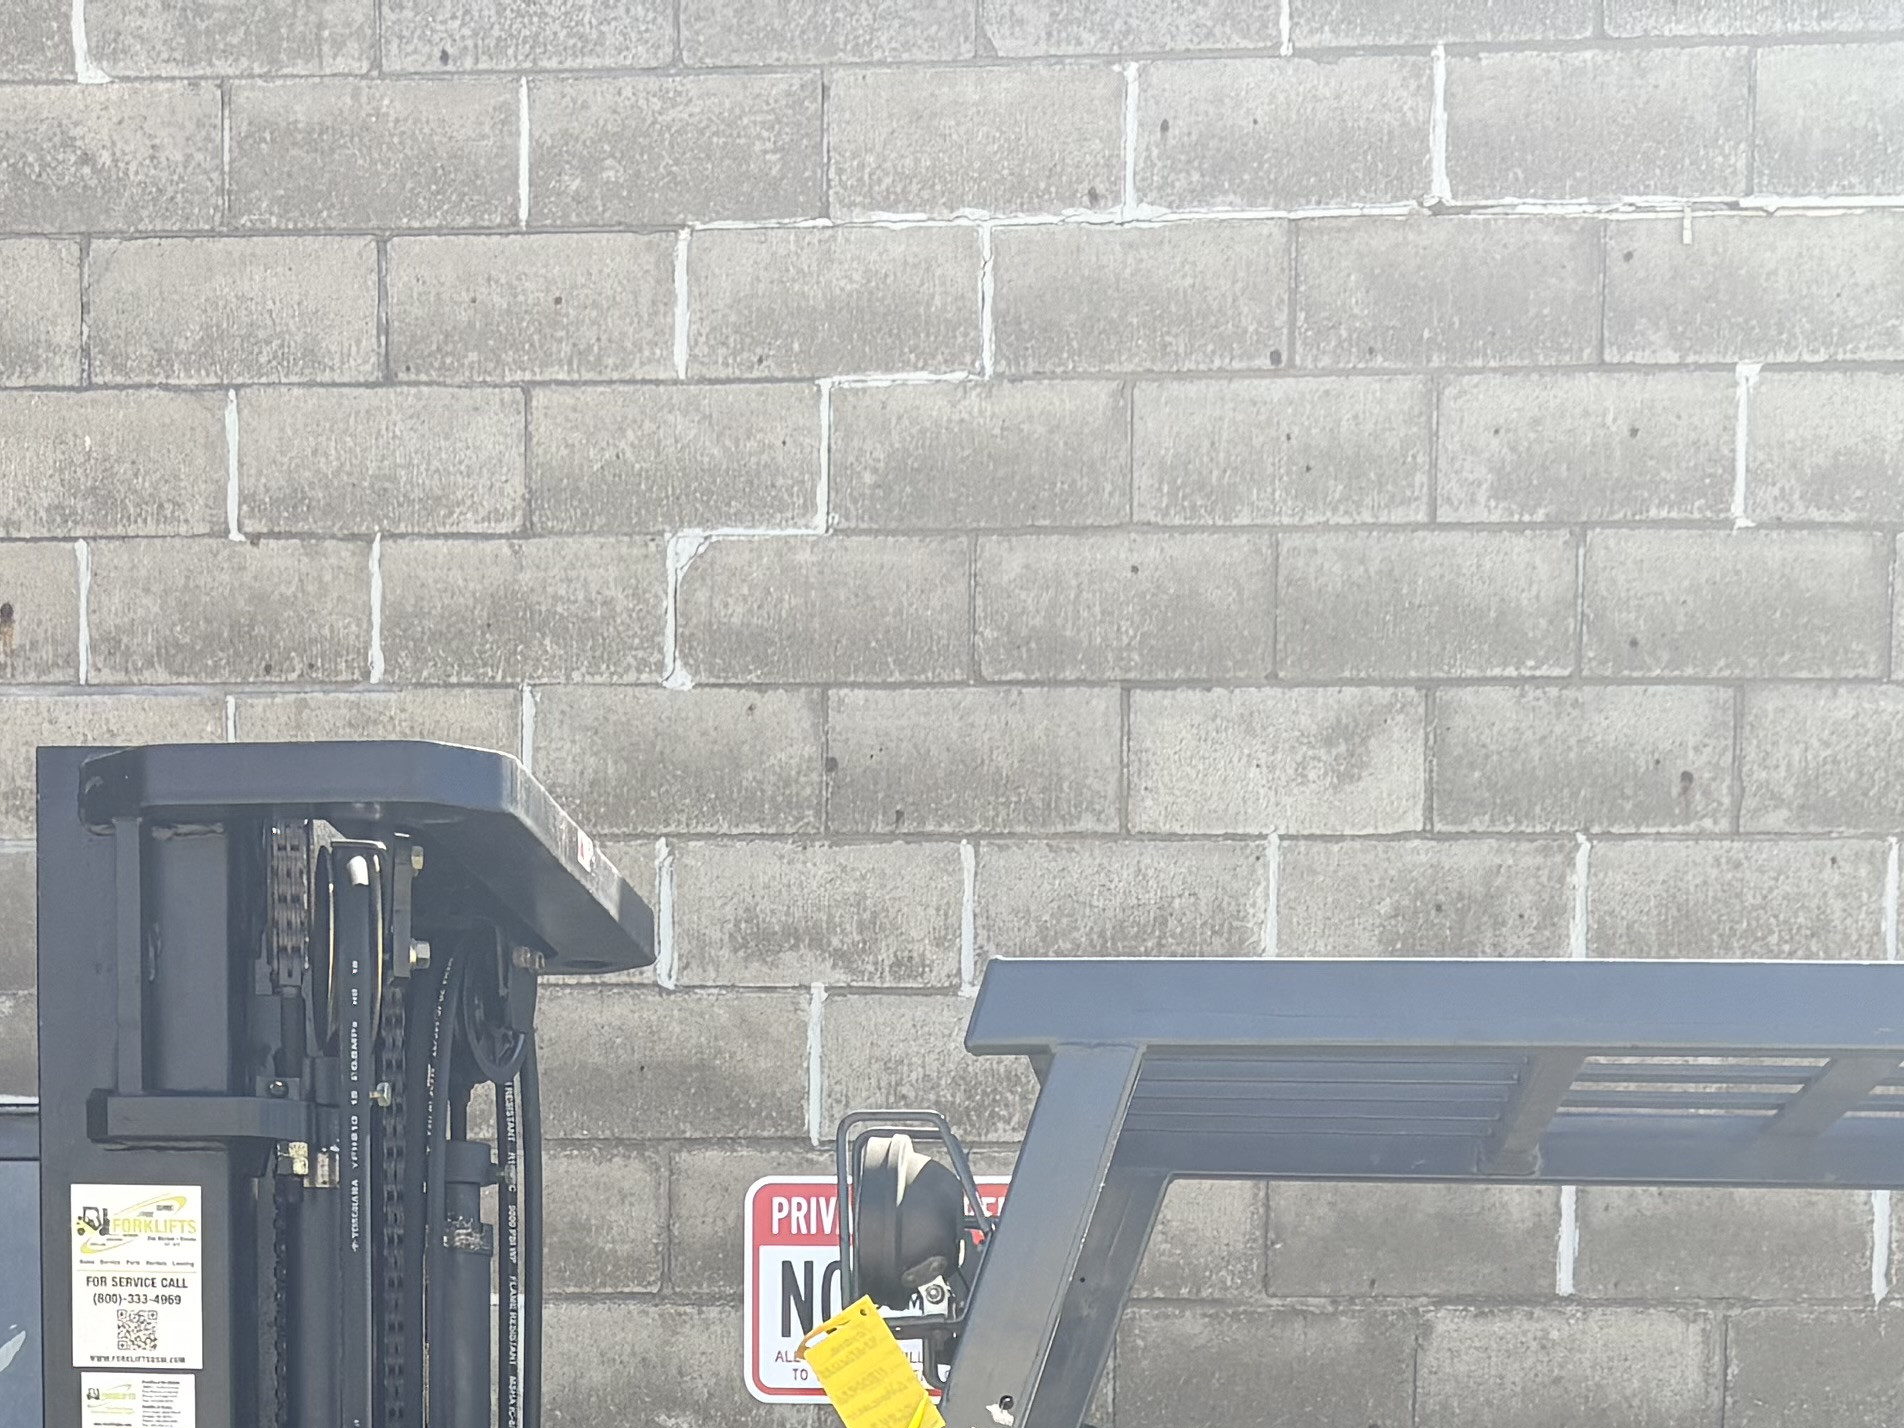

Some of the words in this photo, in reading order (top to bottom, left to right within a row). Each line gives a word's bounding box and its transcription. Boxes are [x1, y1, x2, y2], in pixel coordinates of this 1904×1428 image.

[772, 1196, 839, 1235] PRIV
[112, 1217, 197, 1234] FORKLIFTS
[86, 1275, 107, 1287] FOR
[111, 1276, 157, 1288] SERVICE
[161, 1277, 188, 1289] CALL
[792, 1368, 809, 1381] TO
